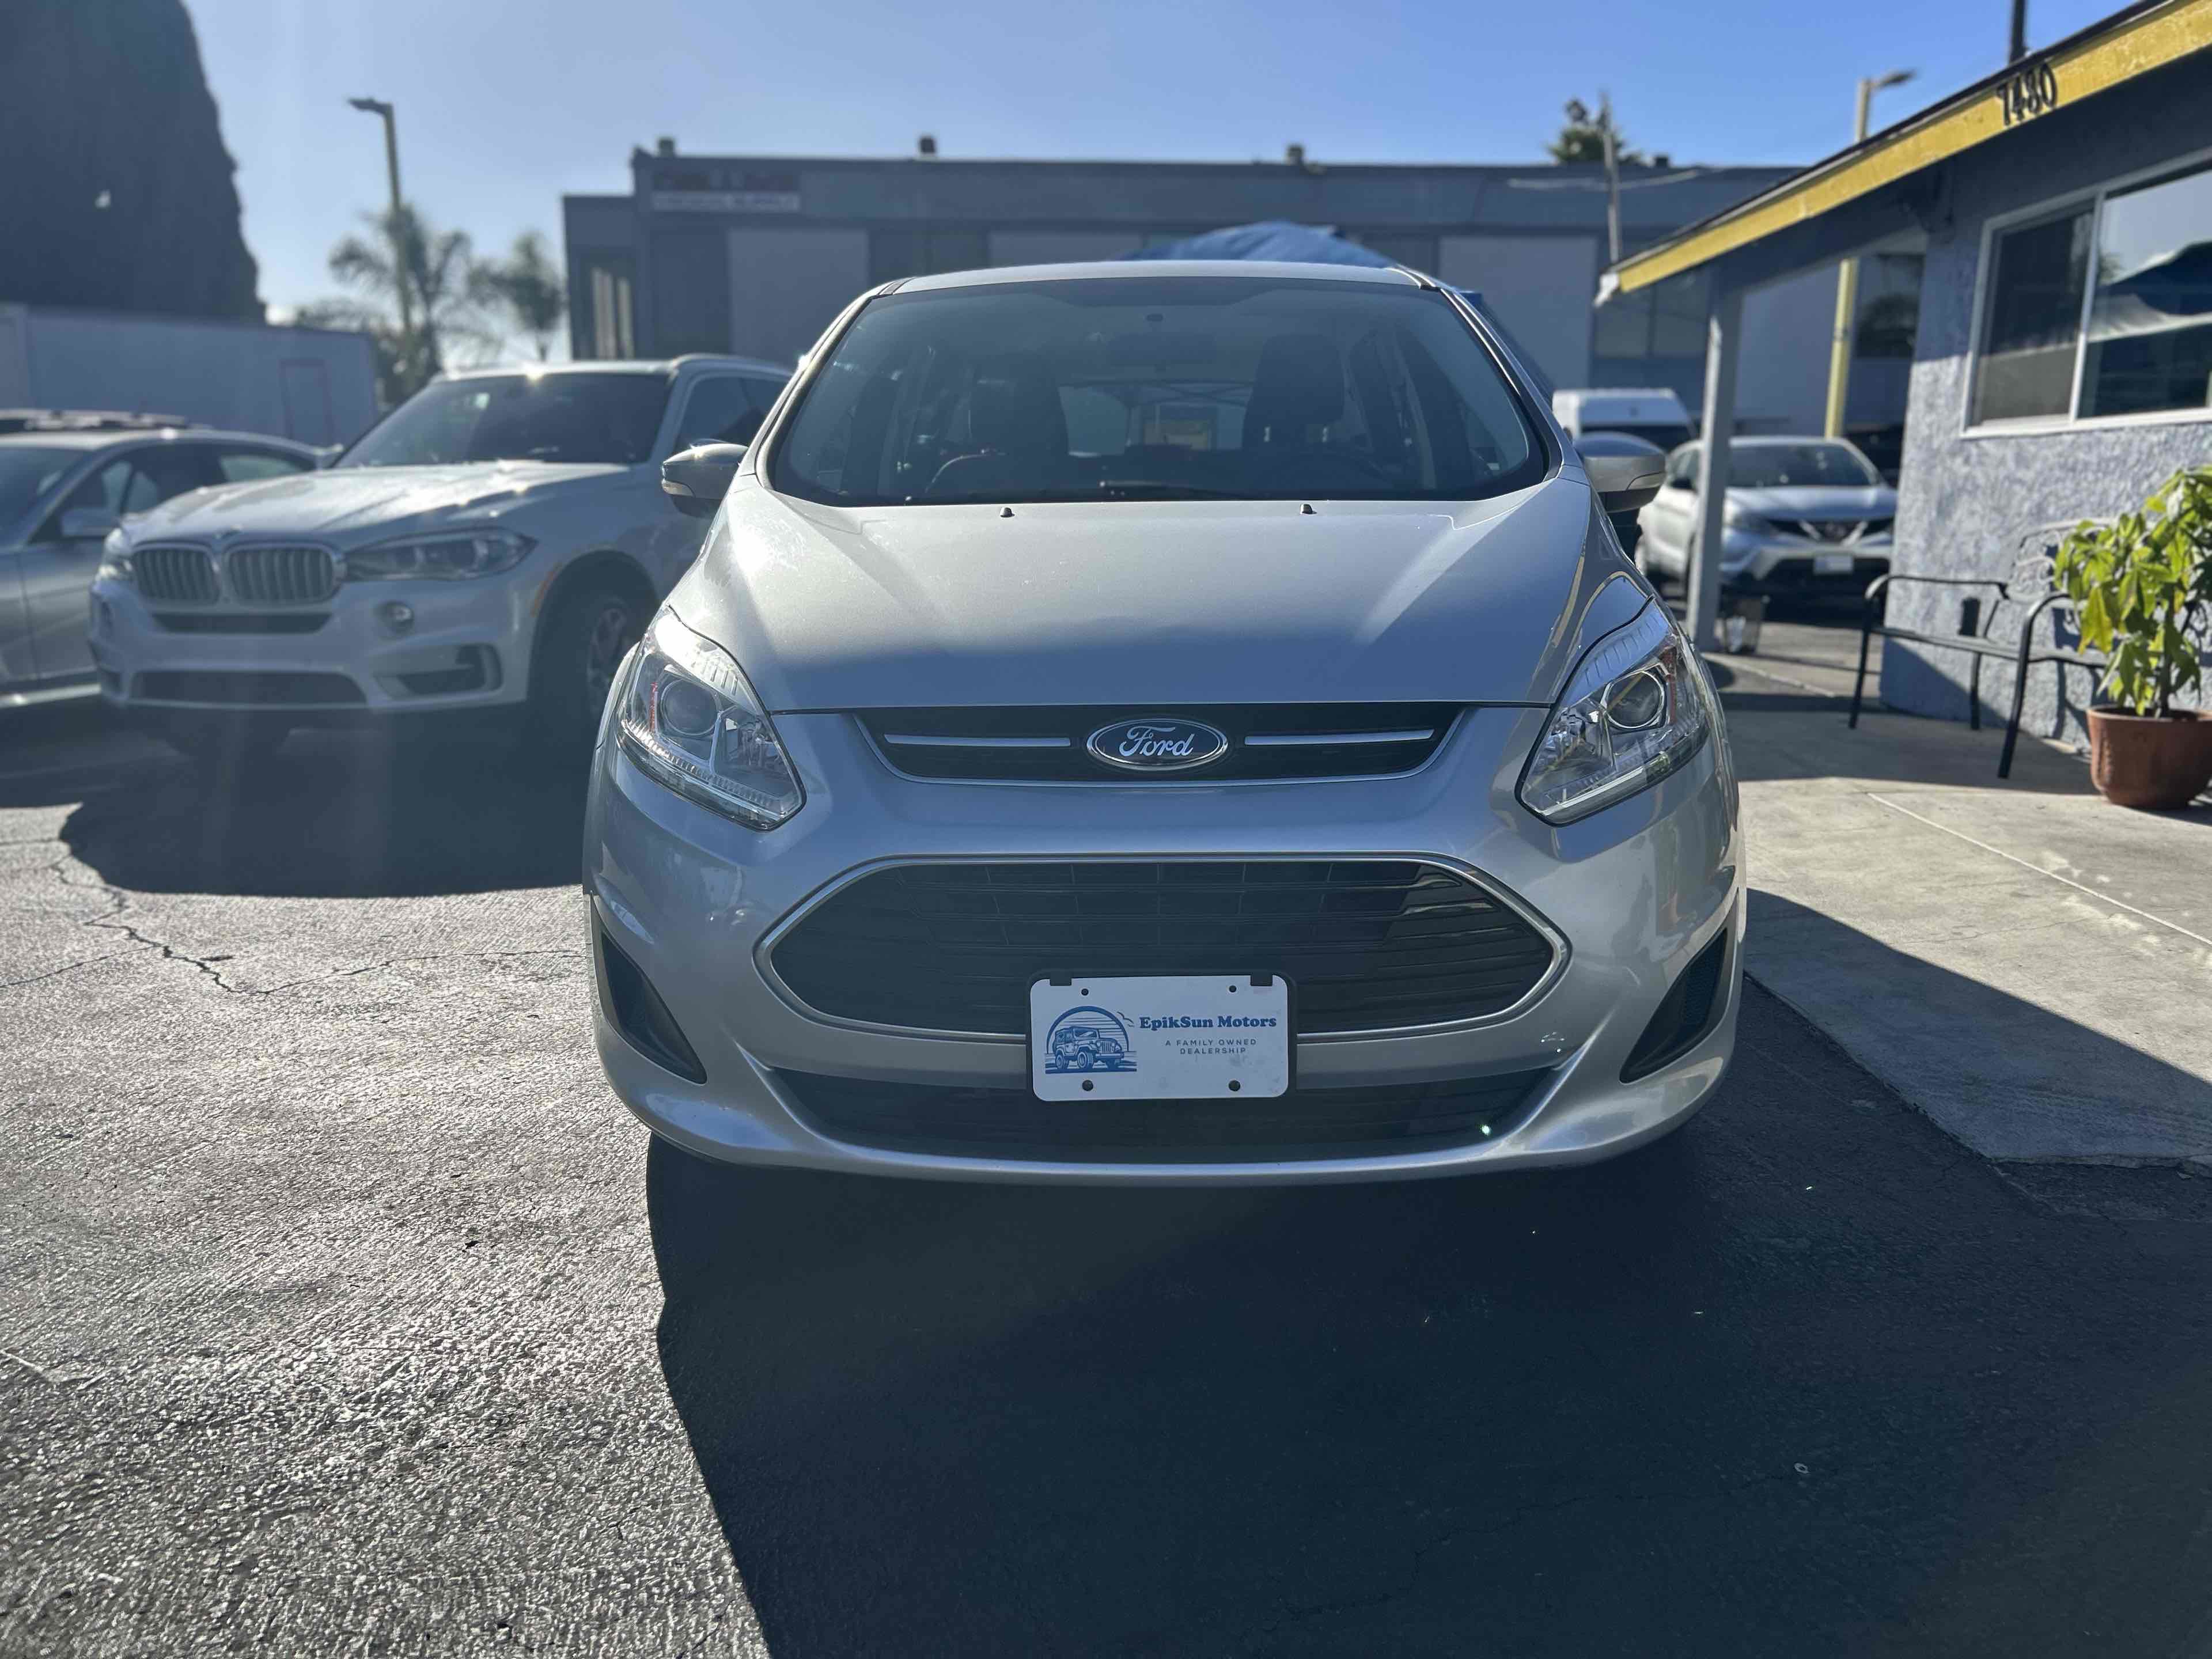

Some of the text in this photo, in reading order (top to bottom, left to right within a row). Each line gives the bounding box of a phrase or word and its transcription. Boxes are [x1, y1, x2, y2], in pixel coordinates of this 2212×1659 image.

[1997, 63, 2057, 126] 7480
[1119, 726, 1195, 756] Ford
[1139, 1016, 1277, 1031] EpikSun Motors
